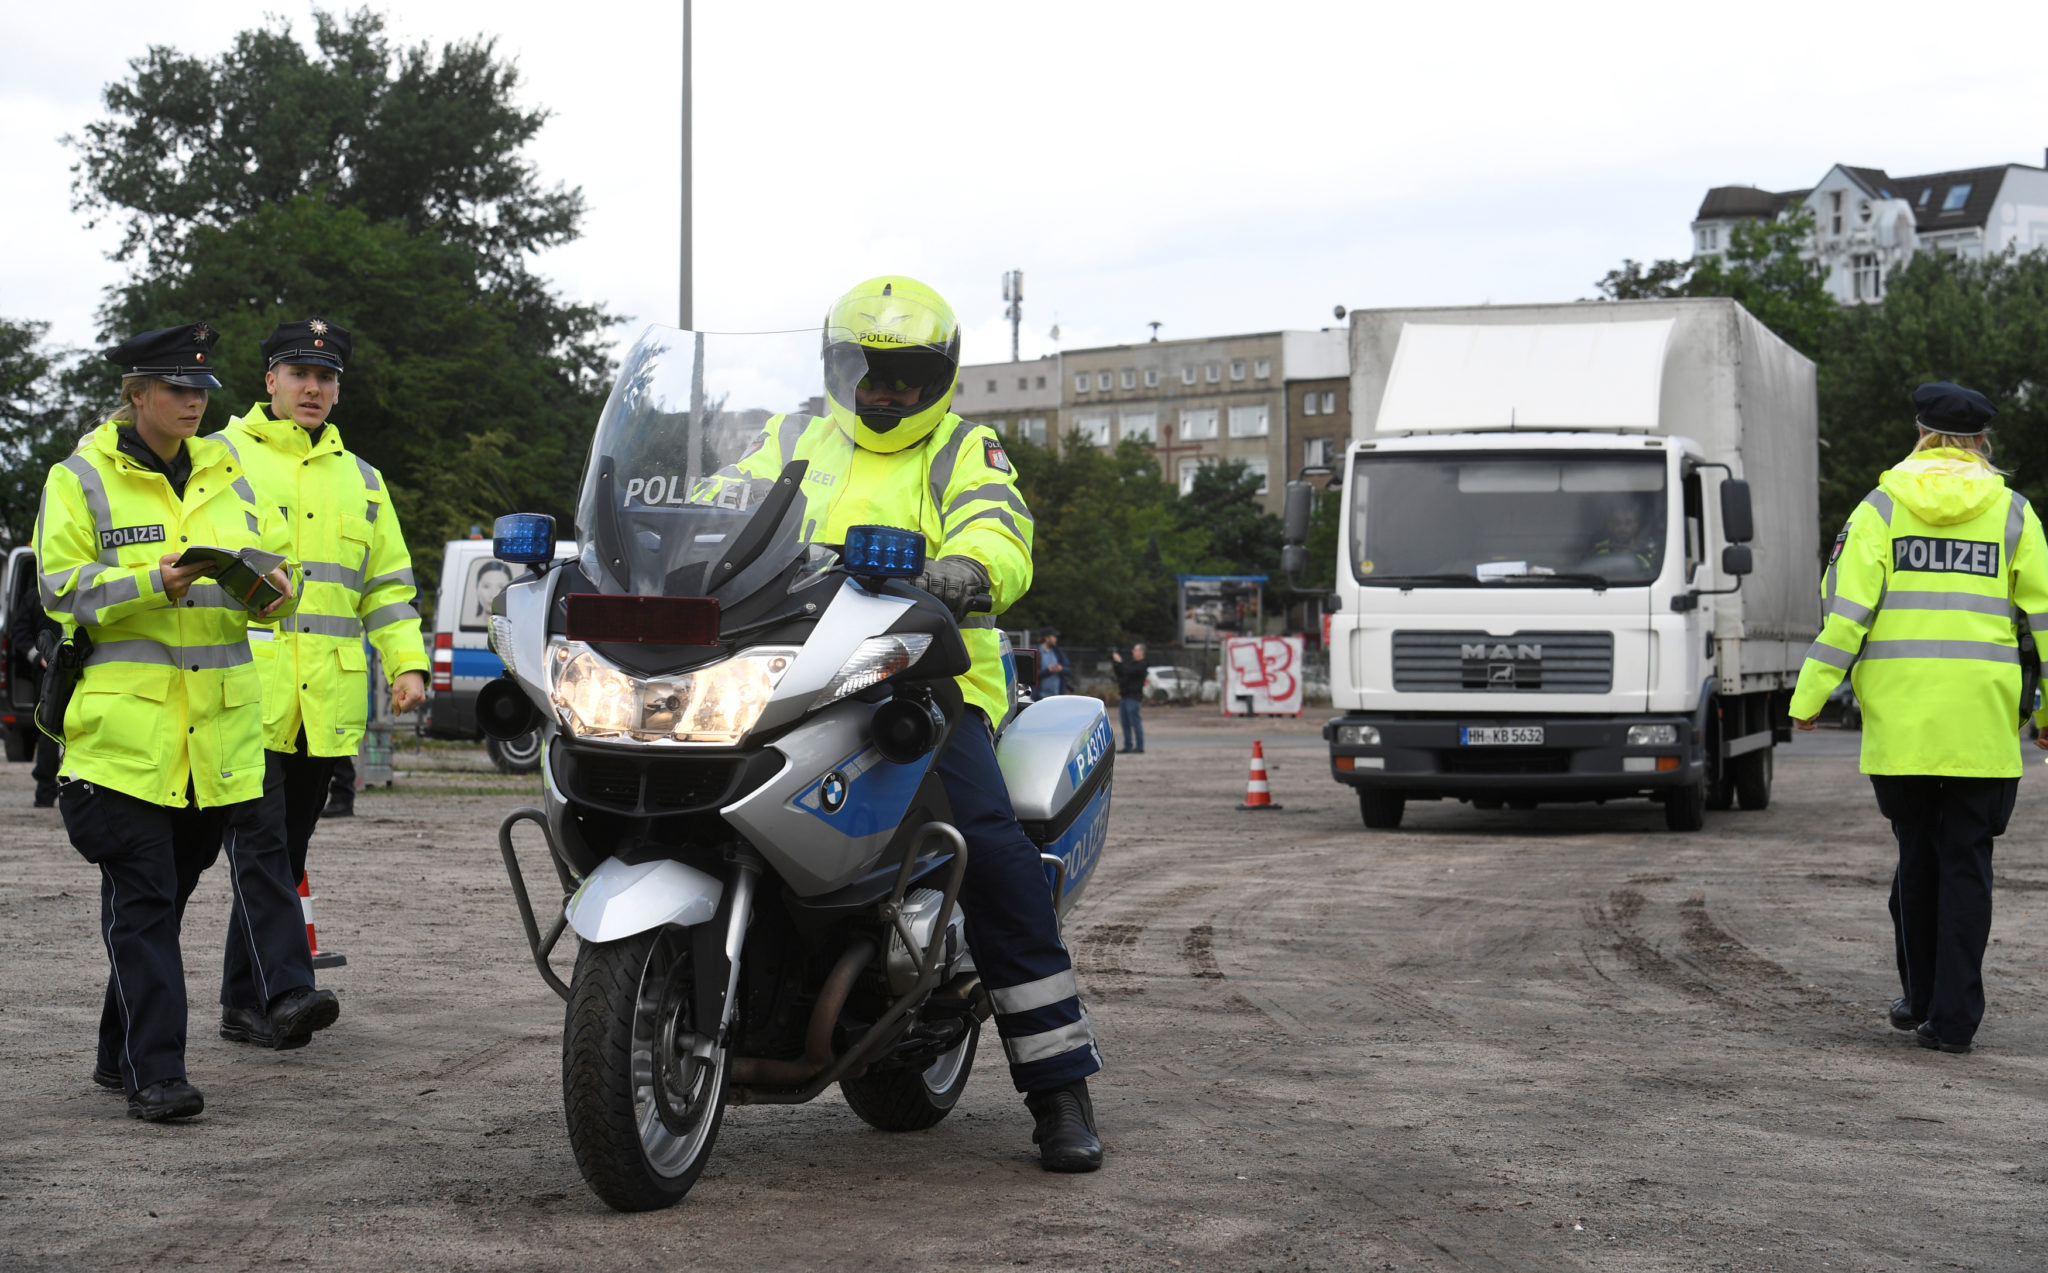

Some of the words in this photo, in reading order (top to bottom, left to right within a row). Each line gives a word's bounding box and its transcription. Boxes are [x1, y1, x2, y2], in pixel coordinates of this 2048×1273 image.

[859, 332, 907, 344] POLIZEI
[623, 475, 751, 512] POLIZEI
[101, 525, 165, 548] POLIZEI
[1895, 539, 1997, 575] POLIZEI
[1461, 644, 1542, 660] MAN
[1468, 729, 1484, 743] HH
[1493, 729, 1509, 743] KB
[1511, 728, 1541, 743] 5632
[1076, 753, 1085, 781] P
[1087, 720, 1107, 766] 43/17
